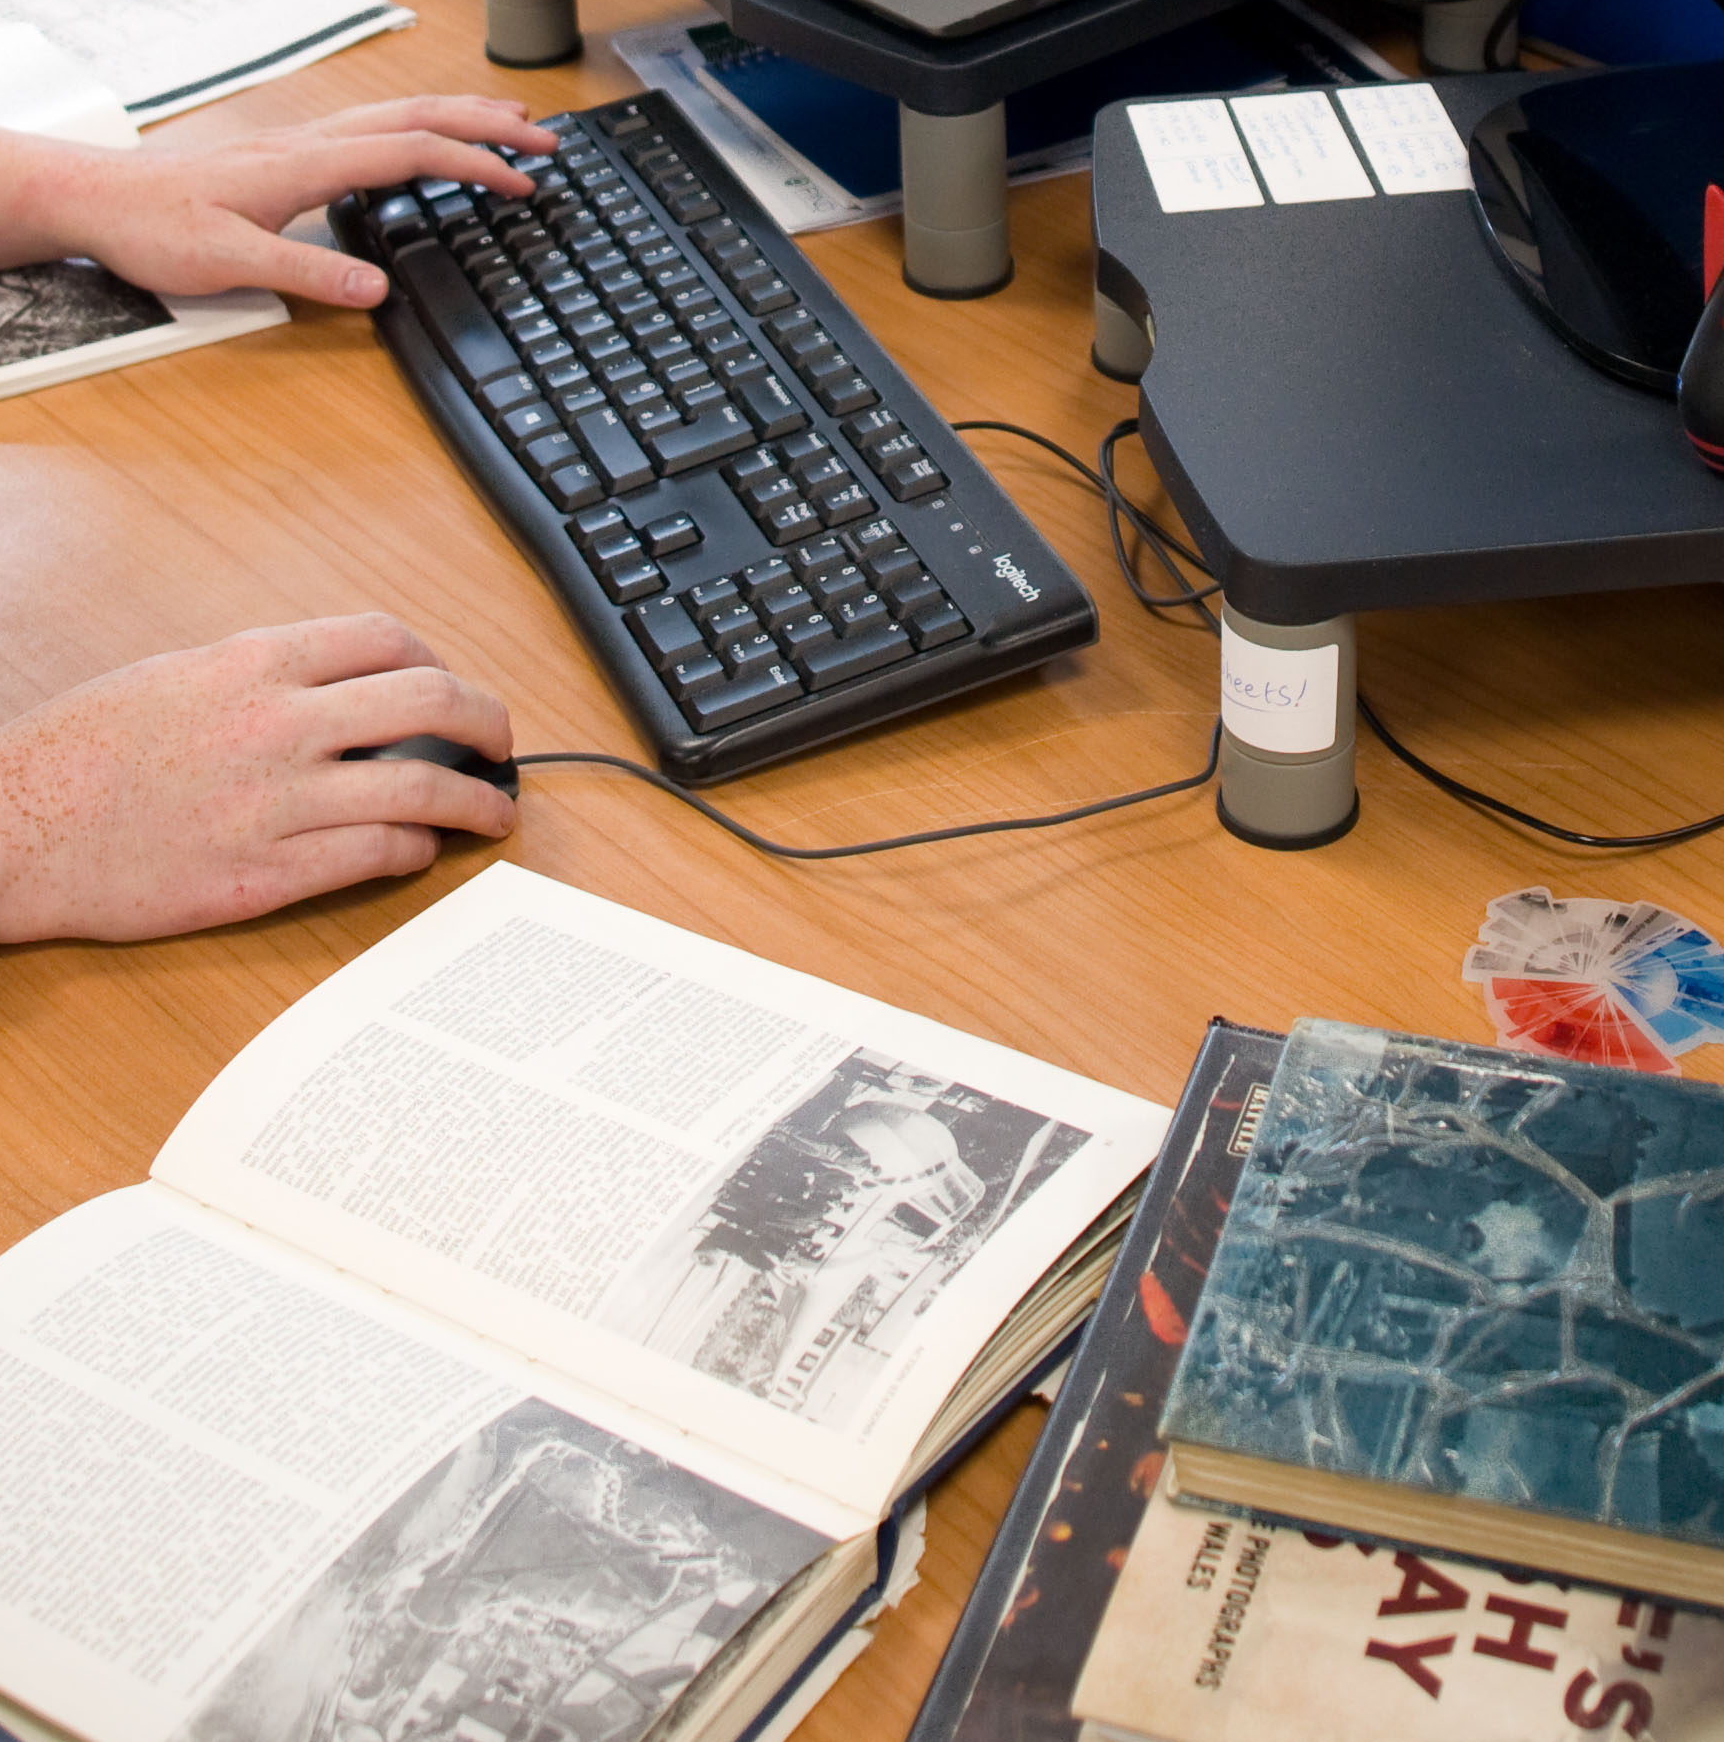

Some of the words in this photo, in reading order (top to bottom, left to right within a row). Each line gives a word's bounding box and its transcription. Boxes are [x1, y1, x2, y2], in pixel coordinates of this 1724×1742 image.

[993, 553, 1041, 602] logitech
[769, 665, 788, 686] Enter
[1222, 654, 1307, 707] heets!
[1186, 1521, 1234, 1594] WALES
[1195, 1534, 1270, 1692] PHOTOGRAPHS
